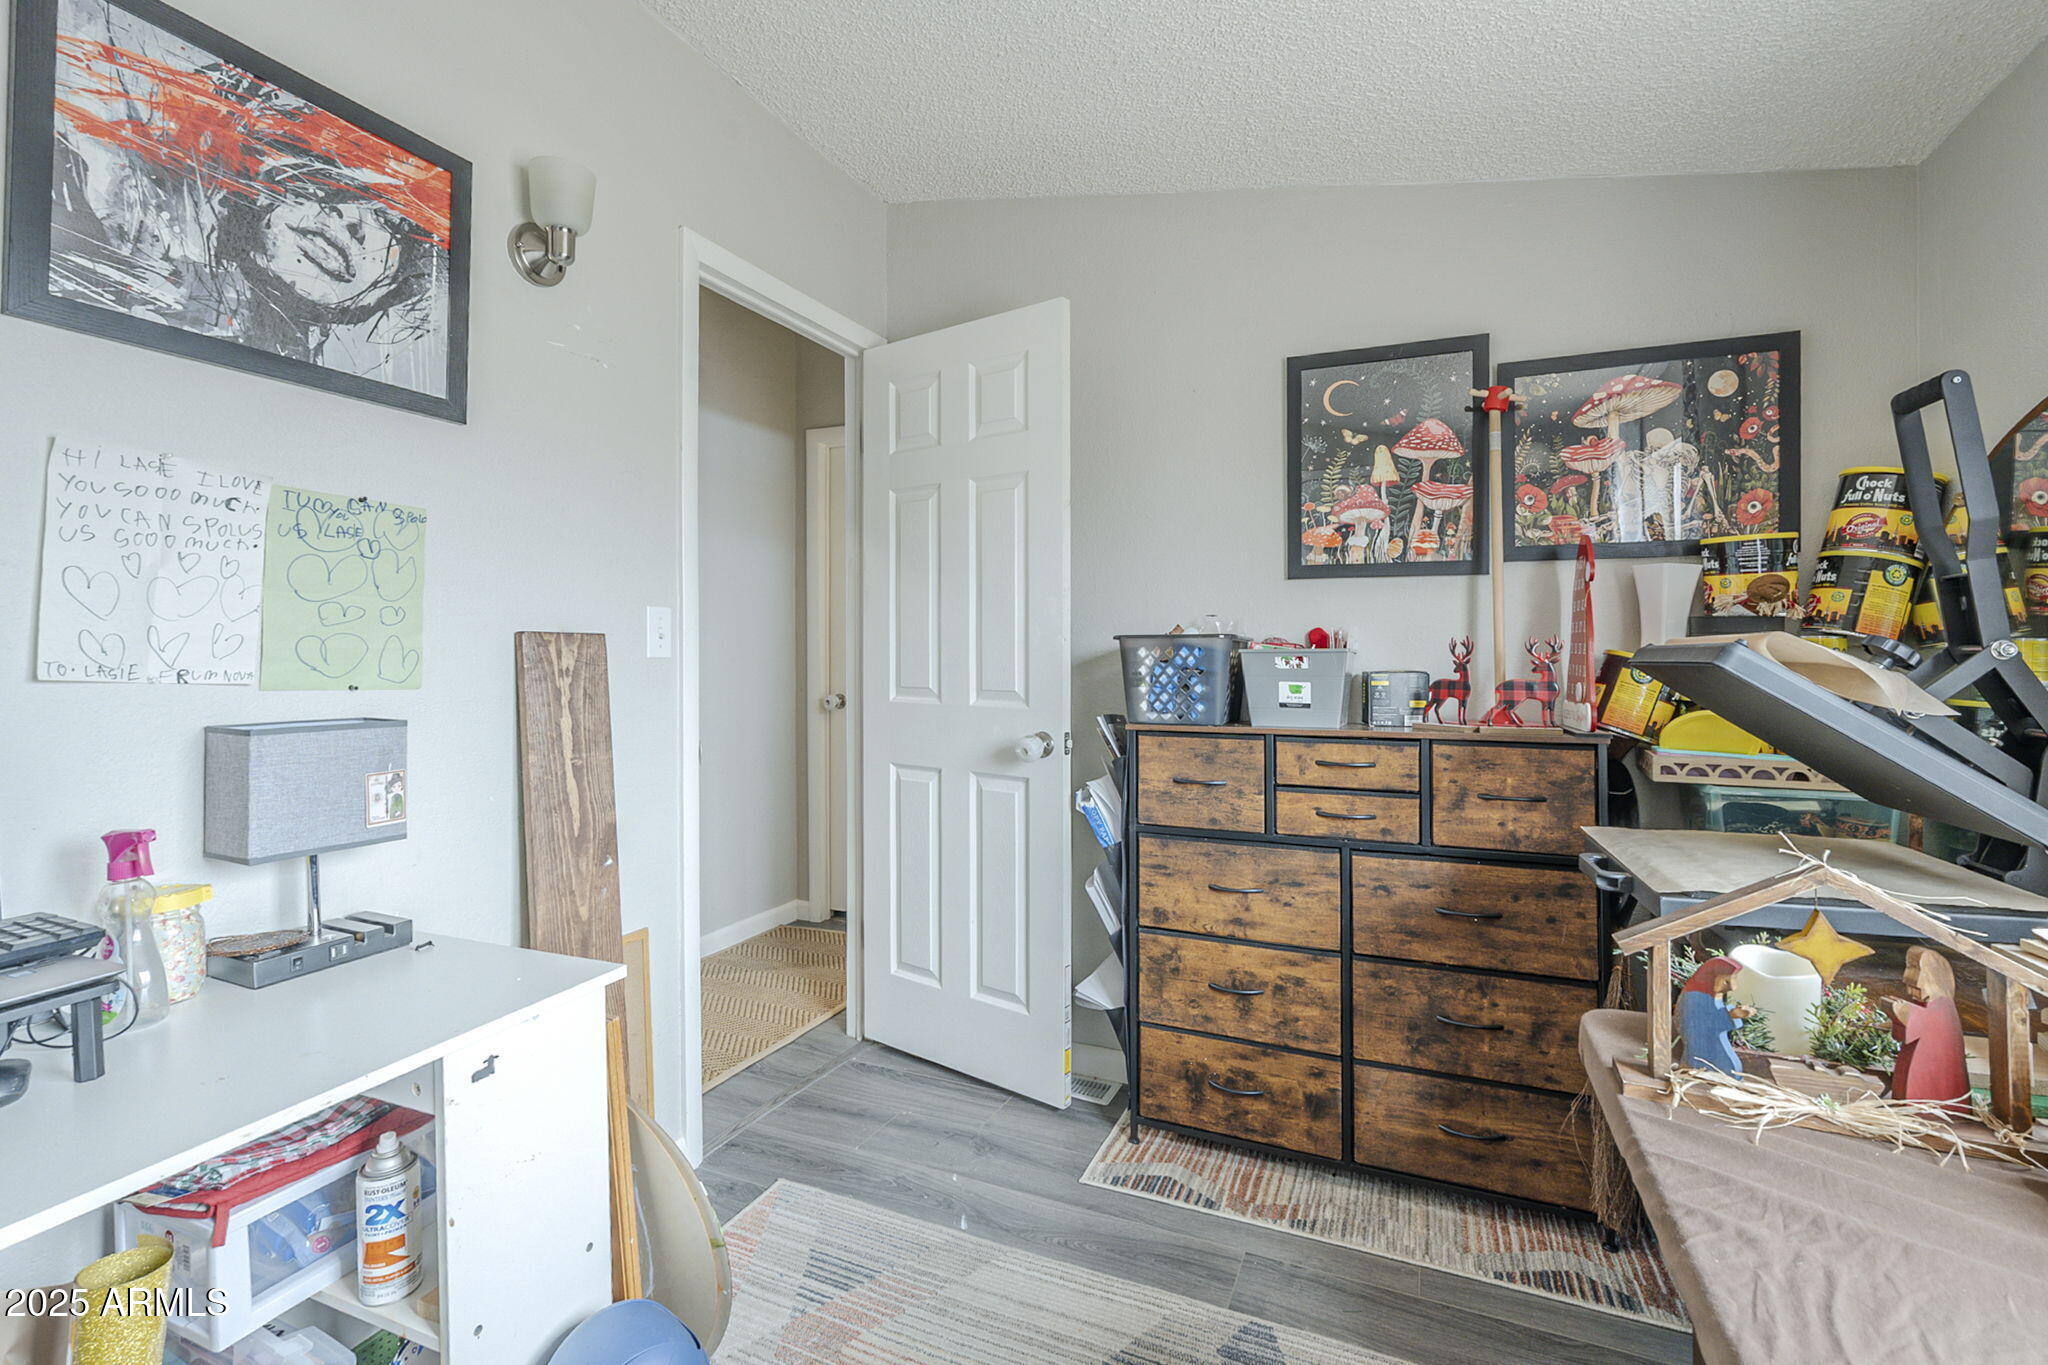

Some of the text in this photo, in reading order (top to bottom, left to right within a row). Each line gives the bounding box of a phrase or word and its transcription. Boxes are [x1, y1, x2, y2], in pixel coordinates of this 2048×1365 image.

[58, 472, 106, 494] YOU
[197, 470, 214, 487] I
[220, 474, 264, 496] LOVE
[1856, 475, 1893, 491] Chock
[1841, 489, 1861, 504] full
[1873, 488, 1906, 503] Nuts
[56, 497, 111, 519] YOU
[121, 508, 171, 532] CAN
[59, 524, 95, 542] US
[365, 1199, 406, 1226] 2X
